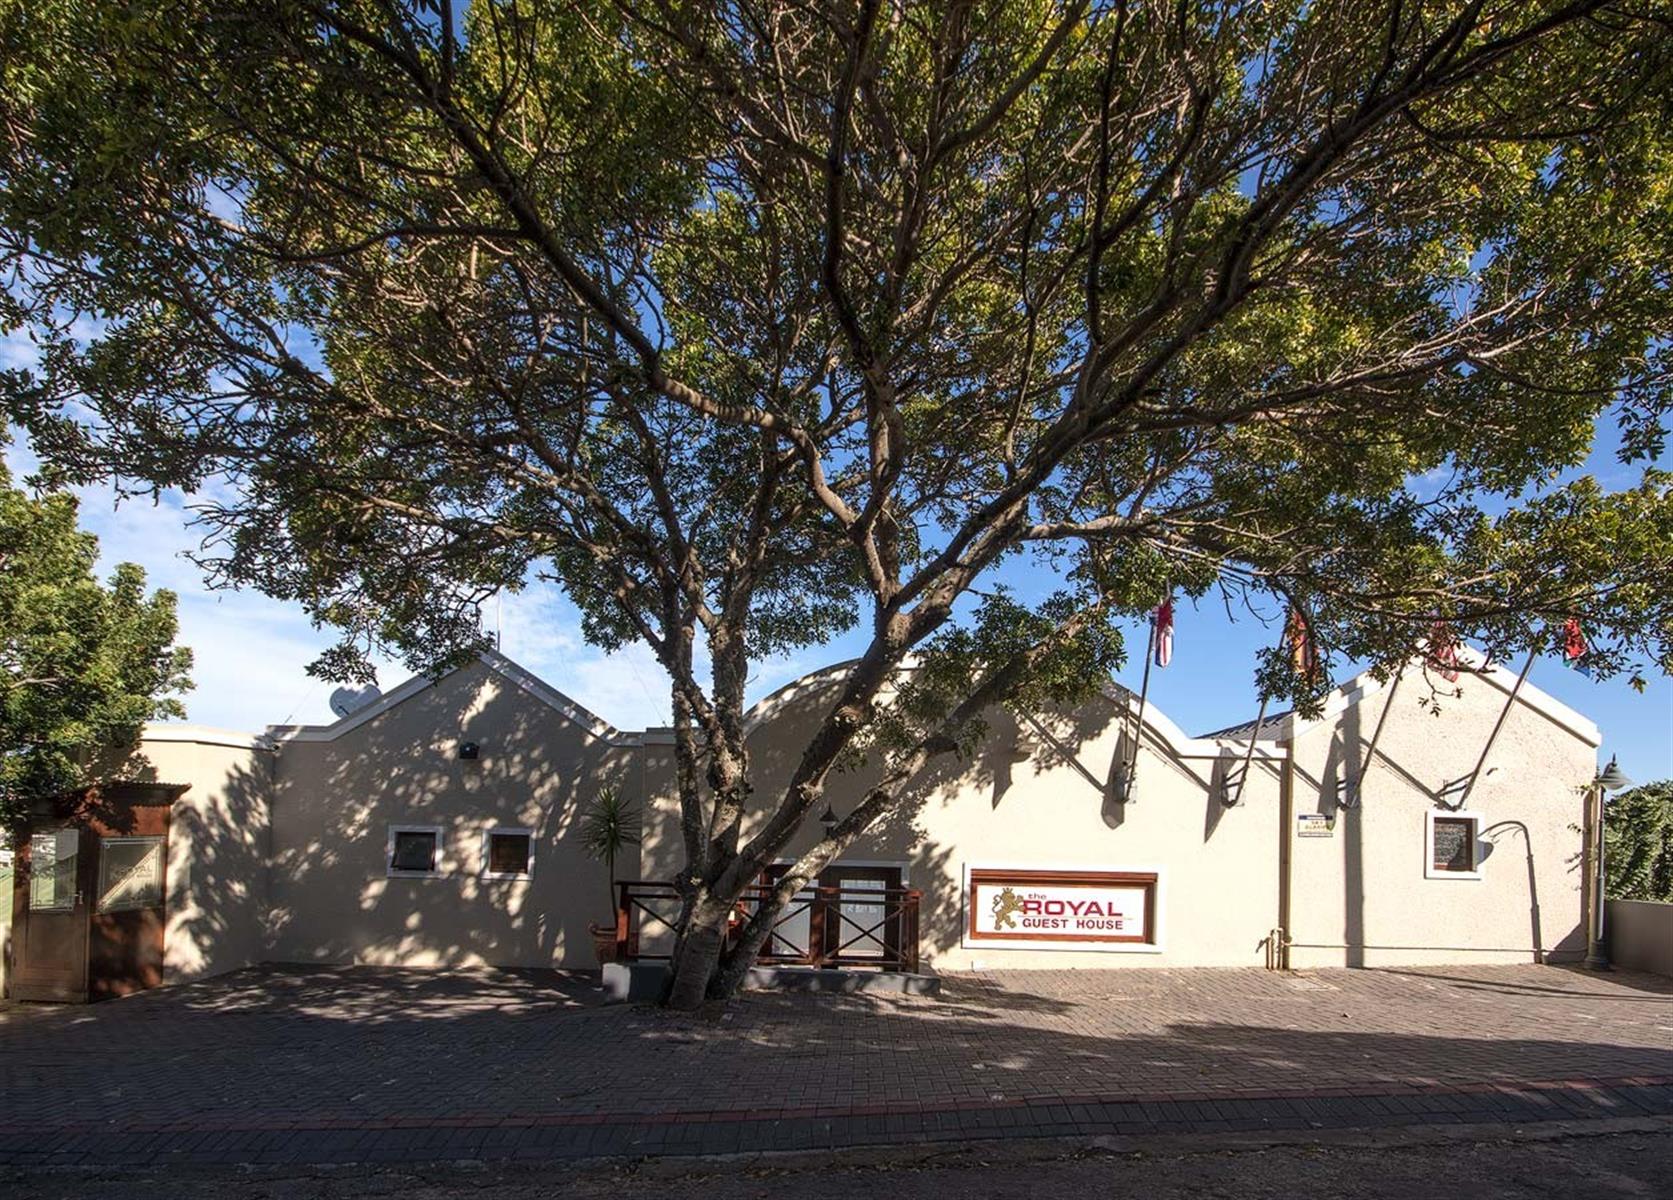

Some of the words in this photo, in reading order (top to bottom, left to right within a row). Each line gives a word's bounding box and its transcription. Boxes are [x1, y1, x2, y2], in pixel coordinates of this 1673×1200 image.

[1028, 892, 1047, 900] the
[1023, 900, 1123, 917] ROYAL
[1022, 918, 1069, 929] GUEST
[1076, 919, 1123, 930] HOUSE
